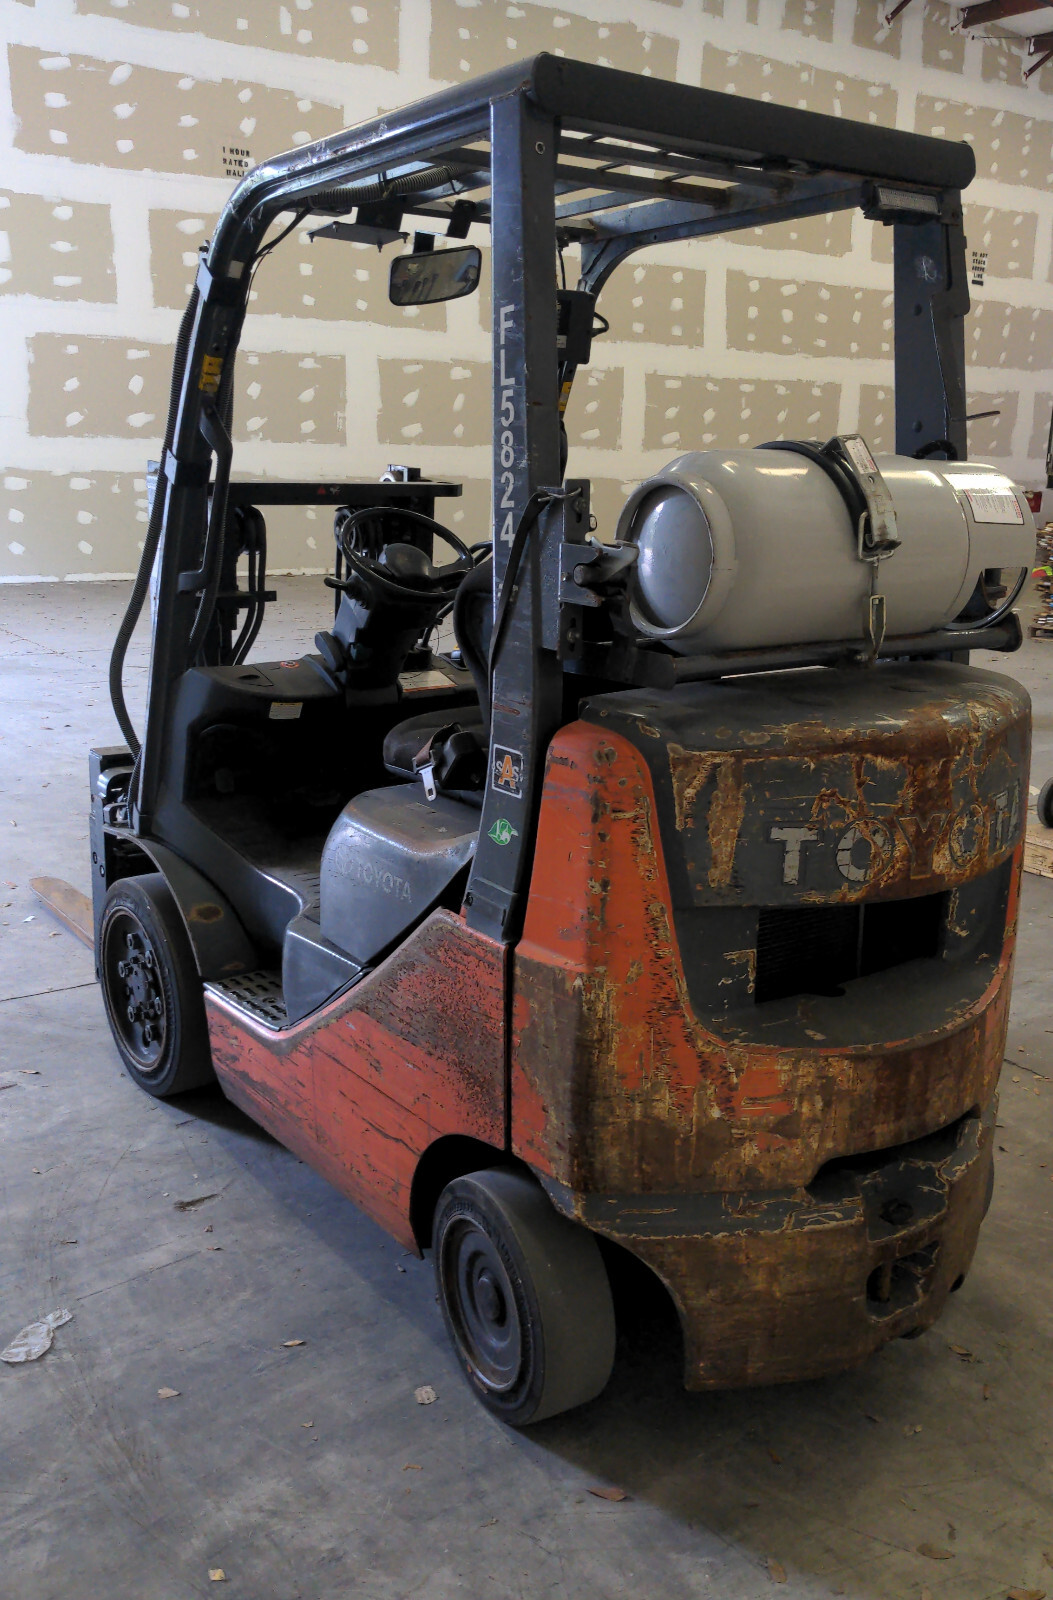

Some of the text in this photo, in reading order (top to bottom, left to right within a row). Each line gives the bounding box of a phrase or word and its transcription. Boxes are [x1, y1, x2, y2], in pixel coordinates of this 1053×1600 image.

[229, 148, 250, 157] HOUR
[222, 158, 249, 167] RATED
[500, 304, 516, 548] FL5824
